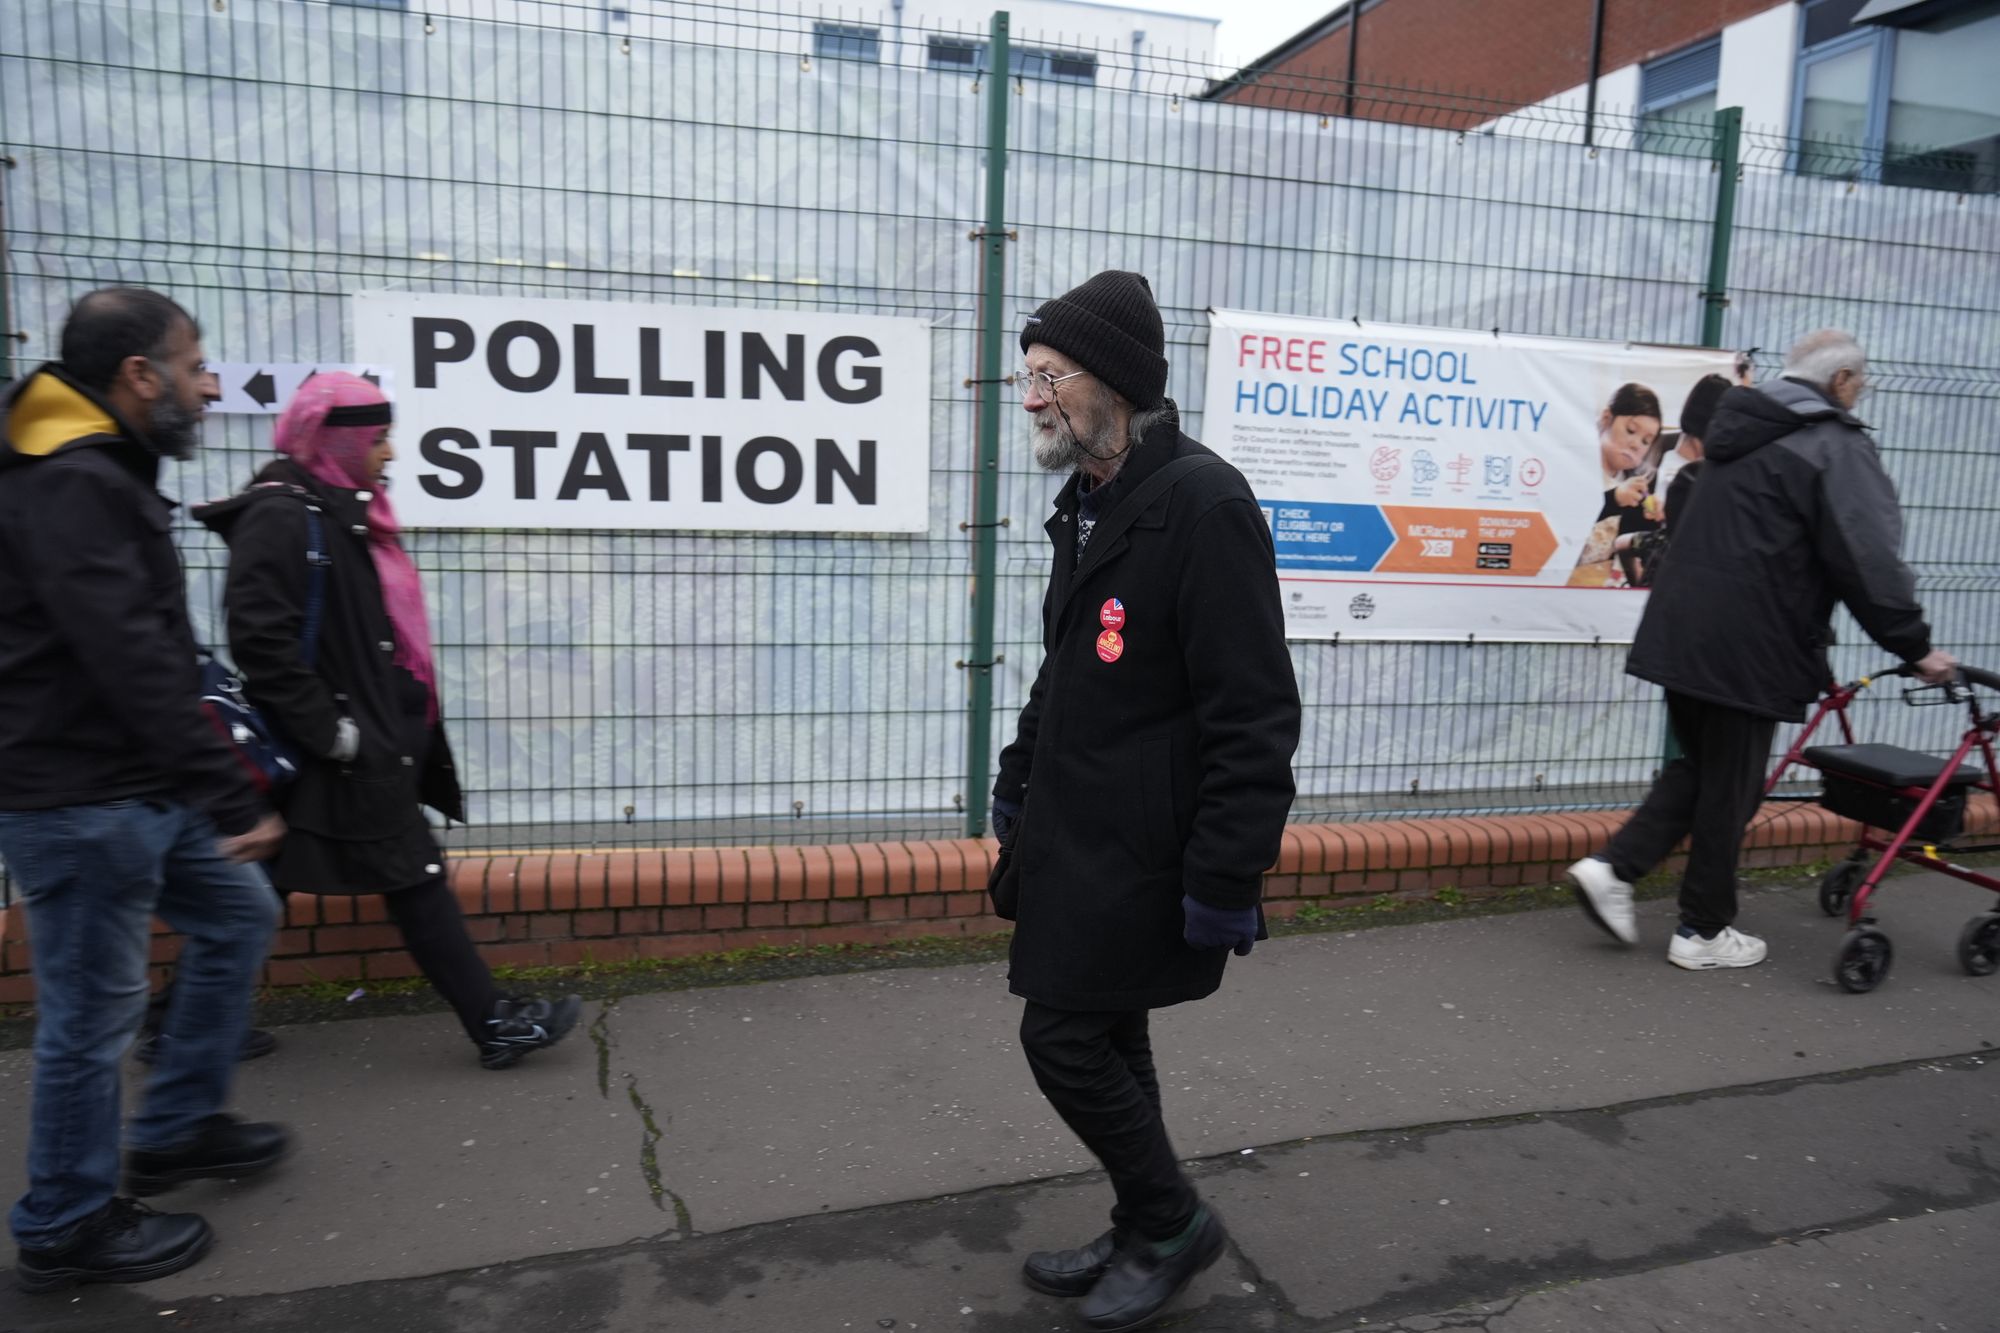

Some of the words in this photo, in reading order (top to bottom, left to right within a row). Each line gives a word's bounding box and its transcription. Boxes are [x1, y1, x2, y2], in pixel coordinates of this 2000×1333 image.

[413, 317, 882, 404] POLLING
[1239, 334, 1326, 374] FREE
[1339, 342, 1477, 385] SCHOOL
[1235, 380, 1389, 422] HOLIDAY
[1399, 392, 1548, 432] ACTIVITY
[418, 427, 878, 505] STATION
[1276, 531, 1304, 542] BOOK
[1305, 532, 1332, 543] HERE
[1277, 520, 1329, 532] ELIGIBILITY
[1331, 522, 1344, 532] OR
[1279, 509, 1311, 519] CHECK
